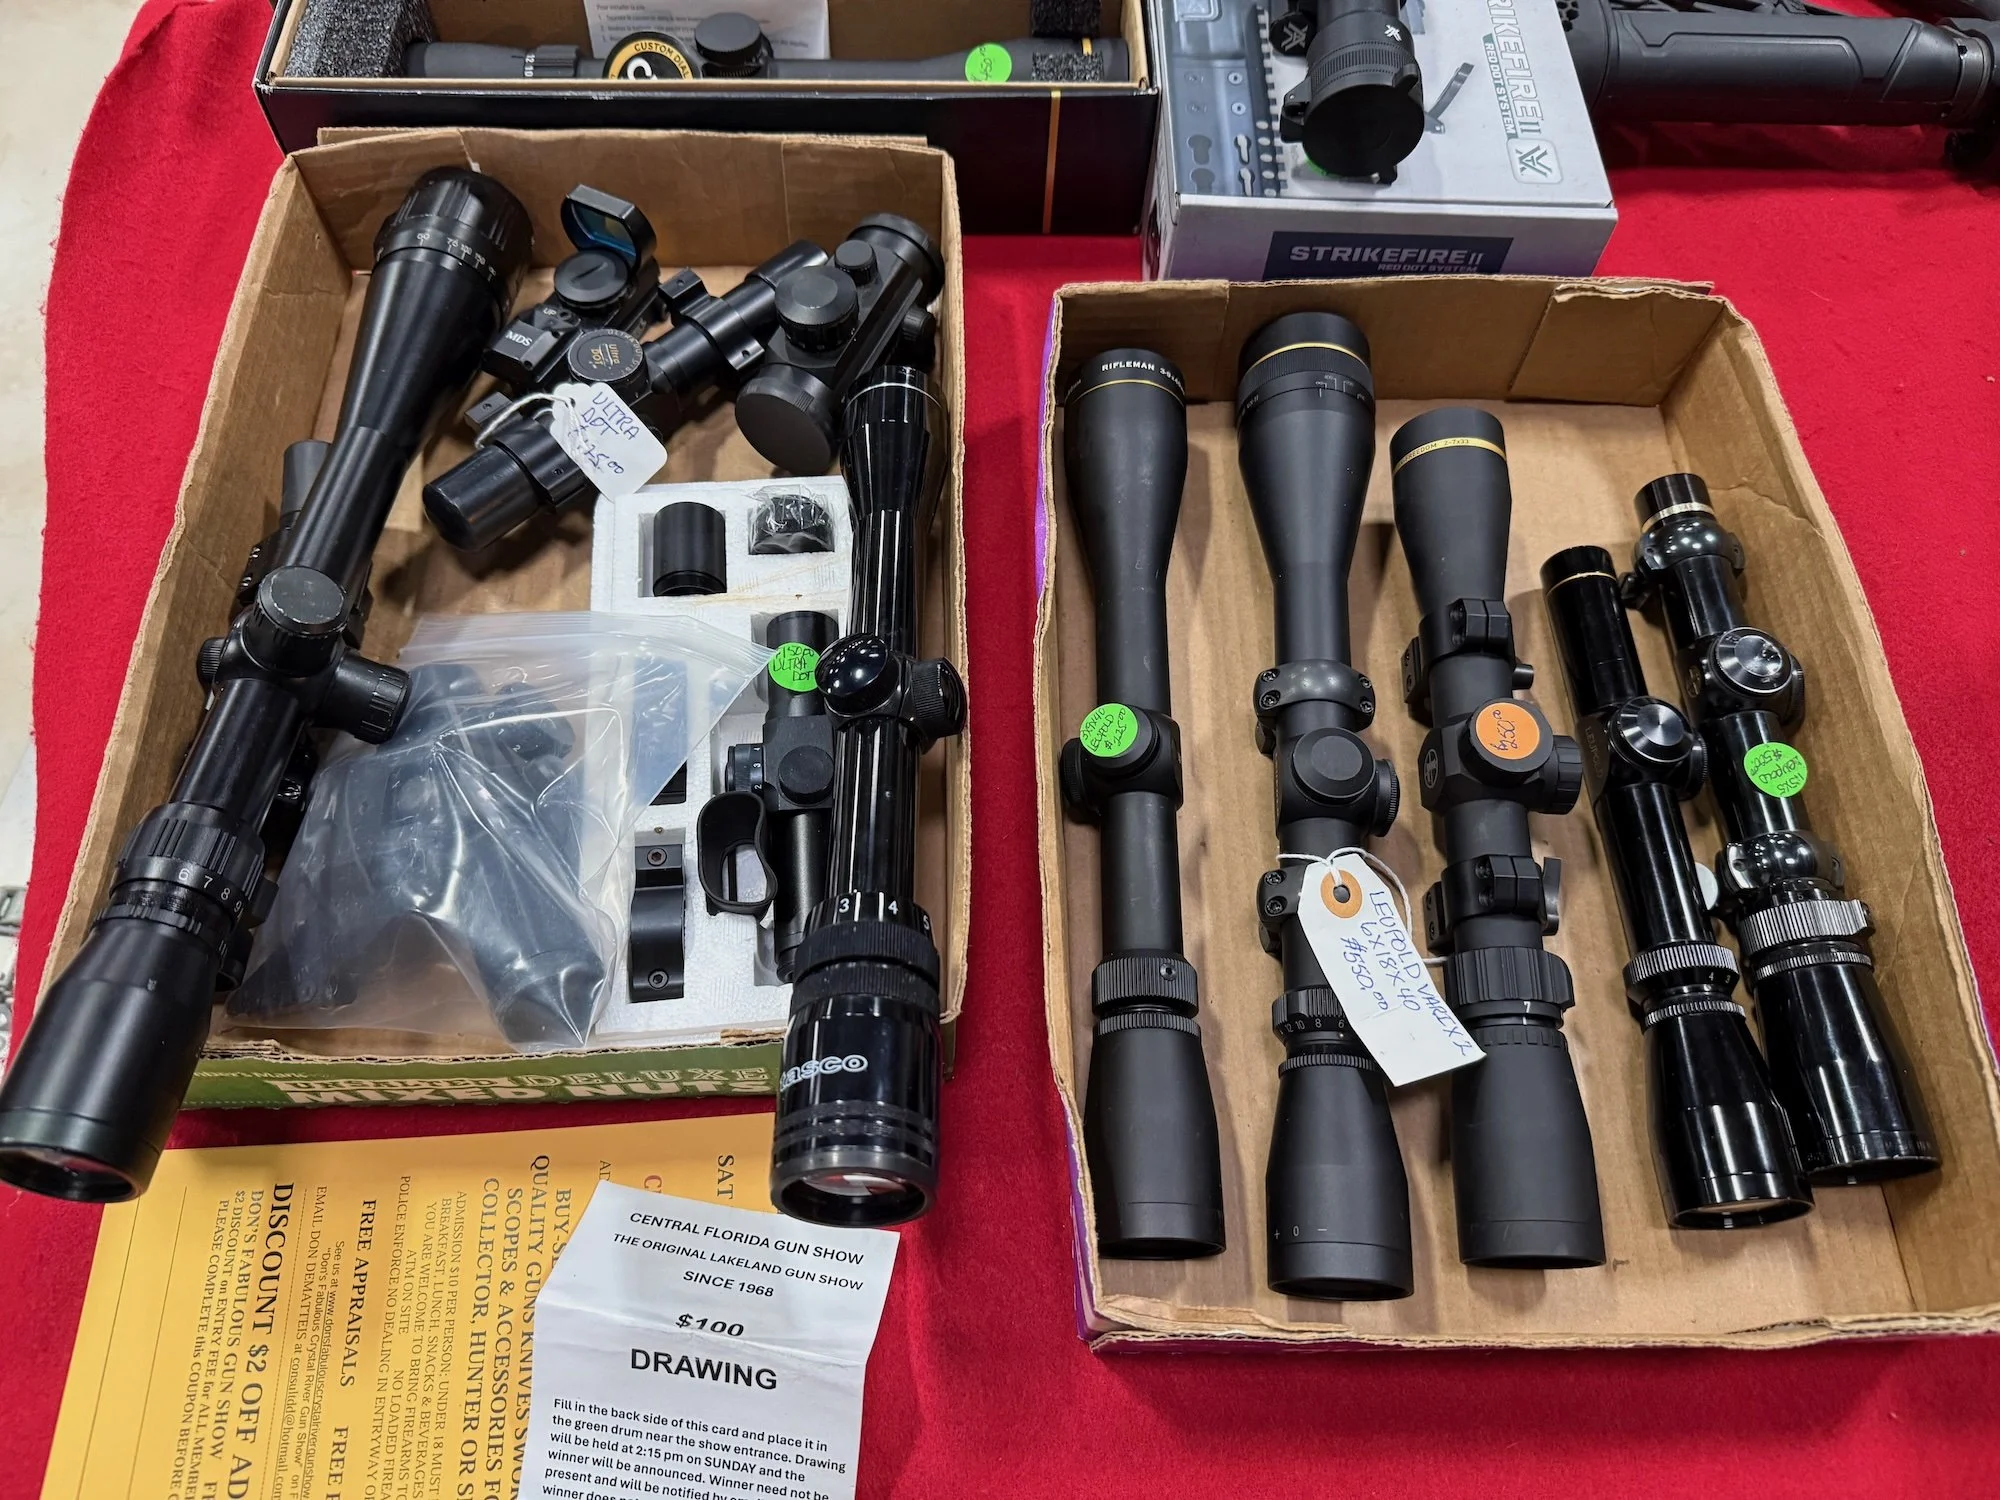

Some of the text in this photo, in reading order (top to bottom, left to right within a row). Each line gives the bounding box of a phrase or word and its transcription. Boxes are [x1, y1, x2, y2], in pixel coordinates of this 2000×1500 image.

[634, 41, 690, 80] CUSTOM DIAL
[1484, 43, 1516, 135] RED DOT SYSTEM
[1290, 246, 1468, 265] STRIKEFIRE
[1378, 264, 1478, 273] RED DOT SYSTEM
[543, 307, 557, 316] UP
[505, 330, 532, 347] MDS
[1102, 360, 1155, 372] RIFLEMAN
[592, 391, 640, 440] ULTRA
[773, 656, 808, 672] ULTRA
[792, 670, 814, 682] DOT
[178, 868, 242, 913] 6 7 8 9
[839, 898, 930, 931] 3 4 5
[1369, 890, 1421, 979] LEUPOLD
[1295, 1020, 1306, 1030] 10
[1315, 1018, 1322, 1028] 8
[1338, 1019, 1345, 1028] 6
[1523, 1000, 1532, 1014] 7
[286, 1080, 771, 1104] MIXED NUTS
[287, 1078, 500, 1091] UNSALTED
[517, 1068, 770, 1088] DELUXE
[244, 1189, 264, 1244] DON'S
[312, 1186, 328, 1228] EMAIL
[528, 1155, 550, 1255] QUALITY
[306, 1230, 321, 1259] DON
[333, 1240, 345, 1262] See
[612, 1232, 864, 1292] THE ORIGINAL LAKELAND GUN SHOW
[629, 1212, 864, 1266] CENTRAL FLORIDA GUN SHOW
[226, 1249, 254, 1347] FABULOUS
[296, 1261, 317, 1340] DEMATTEIS
[340, 1200, 376, 1388] FREE APPRAISALS
[398, 1248, 417, 1334] ATM SITE
[683, 1270, 774, 1298] SINCE 1968
[196, 1206, 244, 1434] DISCOUNT ENTRY FEE ALL
[236, 1182, 295, 1444] DISCOUNT $2 OFF
[366, 1175, 412, 1482] POLICE ENFORCE NO DEALING ENTRYWAY
[458, 1178, 500, 1477] COLLECTOR, HUNTER OR
[486, 1188, 523, 1472] SCOPES ACCESSORIES
[675, 1313, 744, 1338] $100
[170, 1200, 230, 1489] PLEASE COMPLETE COUPON BEFORE
[299, 1284, 327, 1430] Fabulous Crystal River Gun
[399, 1201, 436, 1482] YOU ARE WELCOME BRING FIREARMS
[412, 1198, 452, 1500] BREAKFAST, SNACKS BEVERAGES
[429, 1190, 468, 1495] ADMISSION $10 PER UNDER MUST
[220, 1352, 238, 1394] GUN
[630, 1348, 778, 1390] DRAWING
[210, 1399, 230, 1460] SHOW
[386, 1369, 404, 1454] NO LOADED
[554, 1398, 802, 1450] Fill the back side this card and place
[327, 1426, 349, 1486] FREE
[550, 1432, 806, 1483] will held 2:15 pm SUNDAY and the
[552, 1414, 846, 1474] the green drum near the show entrance. Drawing
[542, 1484, 584, 1500] winner
[544, 1466, 710, 1500] present and will notified
[548, 1450, 788, 1498] winner will announced. Winner need
